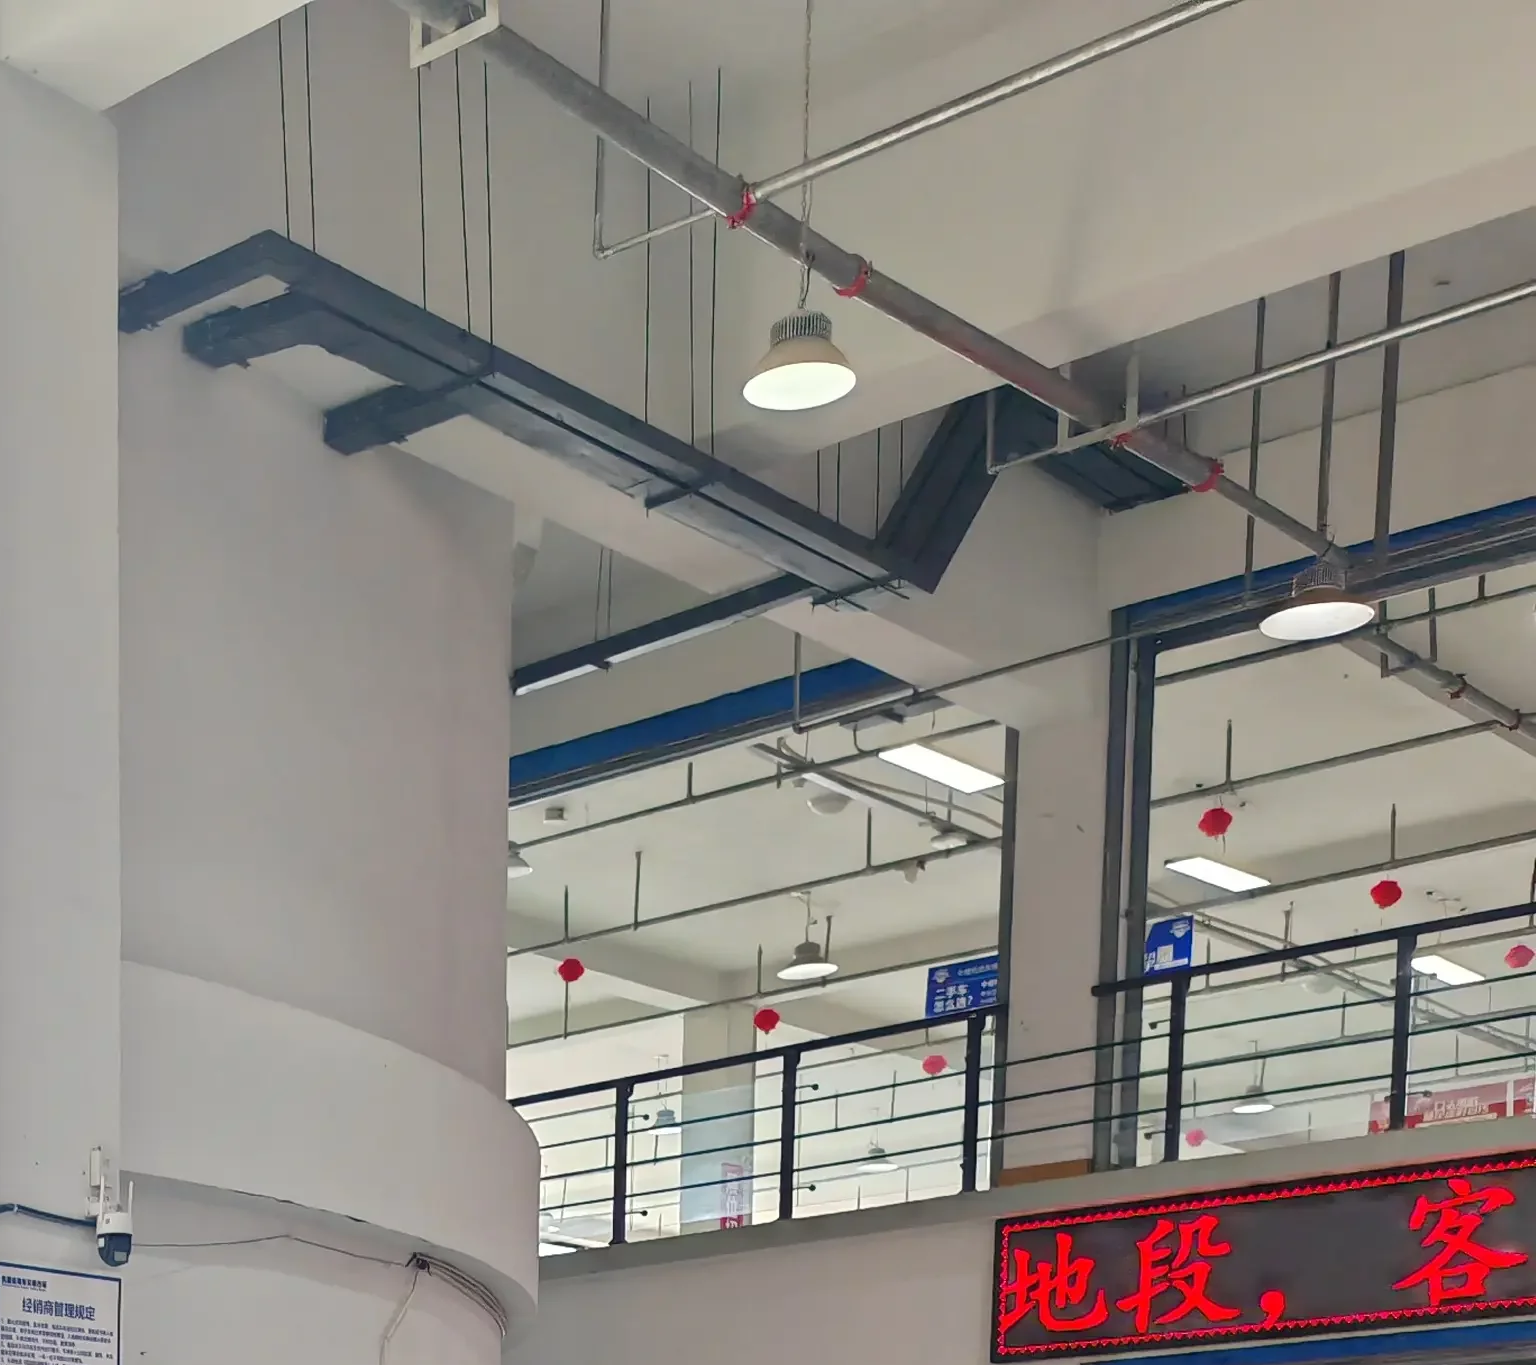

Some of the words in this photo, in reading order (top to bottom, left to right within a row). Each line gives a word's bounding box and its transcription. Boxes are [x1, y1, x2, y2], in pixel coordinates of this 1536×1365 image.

[22, 1296, 96, 1321] 经销商管理规定
